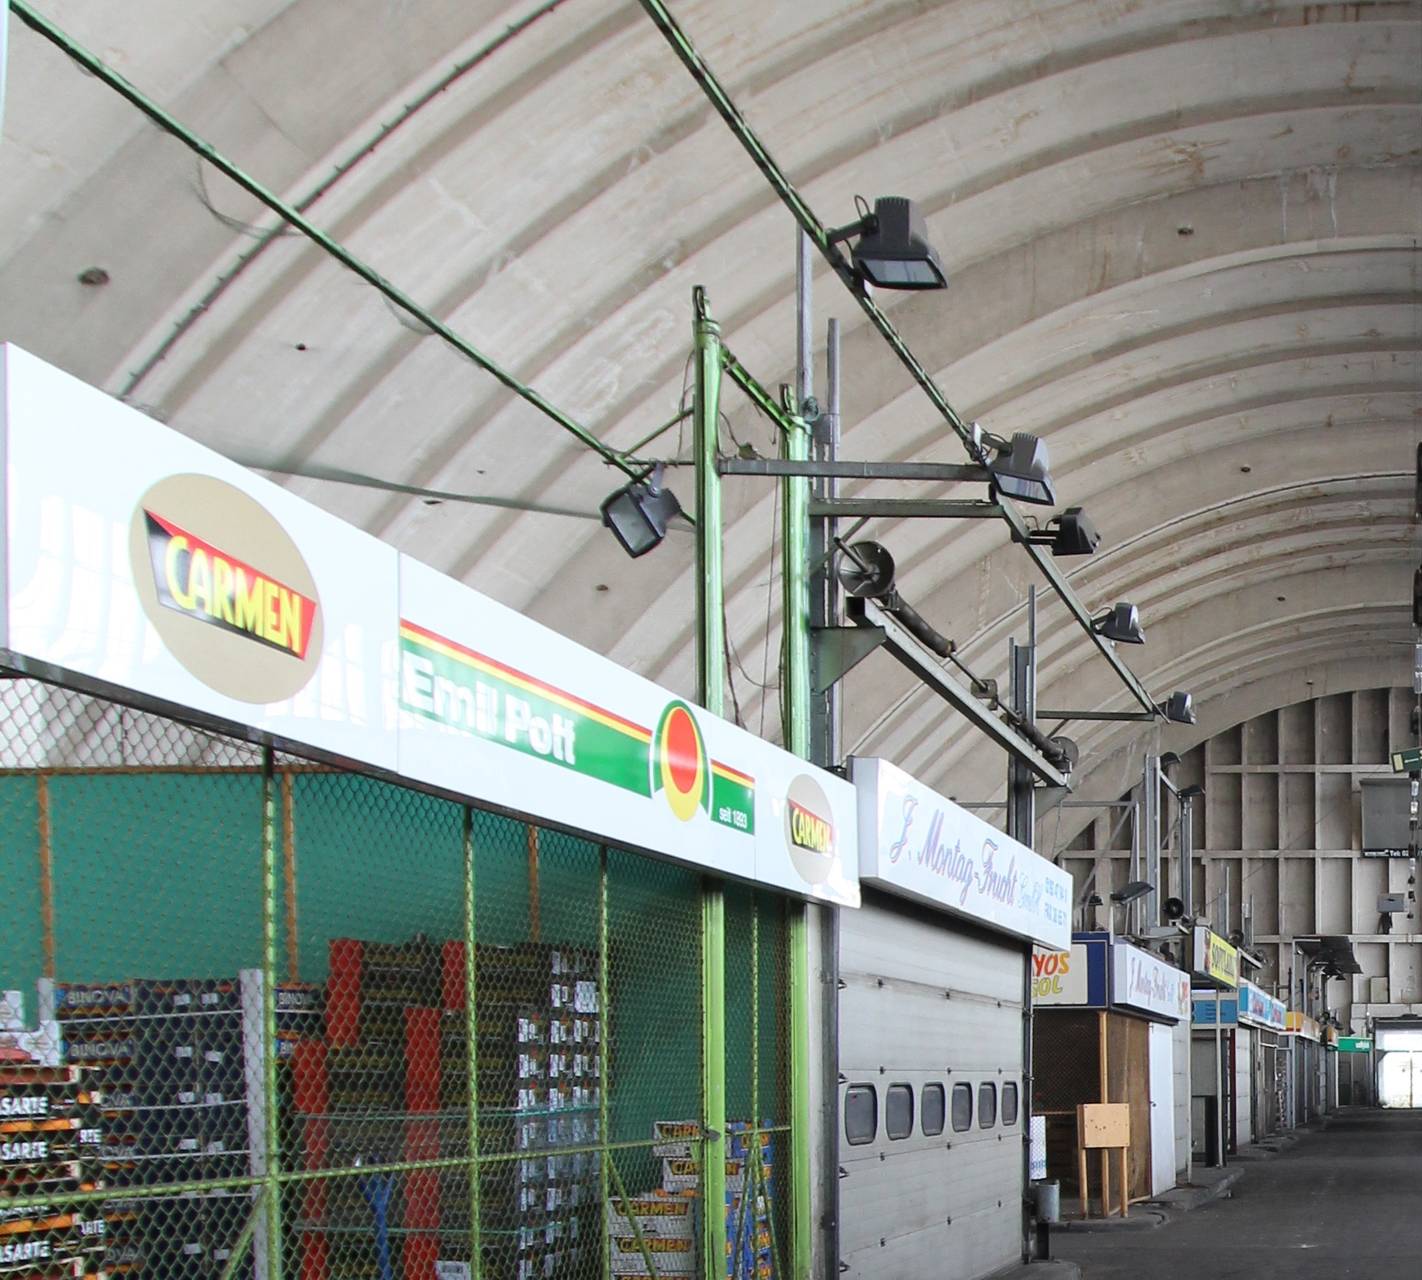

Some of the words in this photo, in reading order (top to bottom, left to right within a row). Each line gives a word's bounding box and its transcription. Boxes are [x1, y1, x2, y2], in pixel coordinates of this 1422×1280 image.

[165, 535, 302, 655] CARMEN
[402, 650, 498, 737] Emil
[504, 692, 576, 766] Pott
[792, 807, 830, 855] CARMEN
[0, 1240, 50, 1262] SARTE
